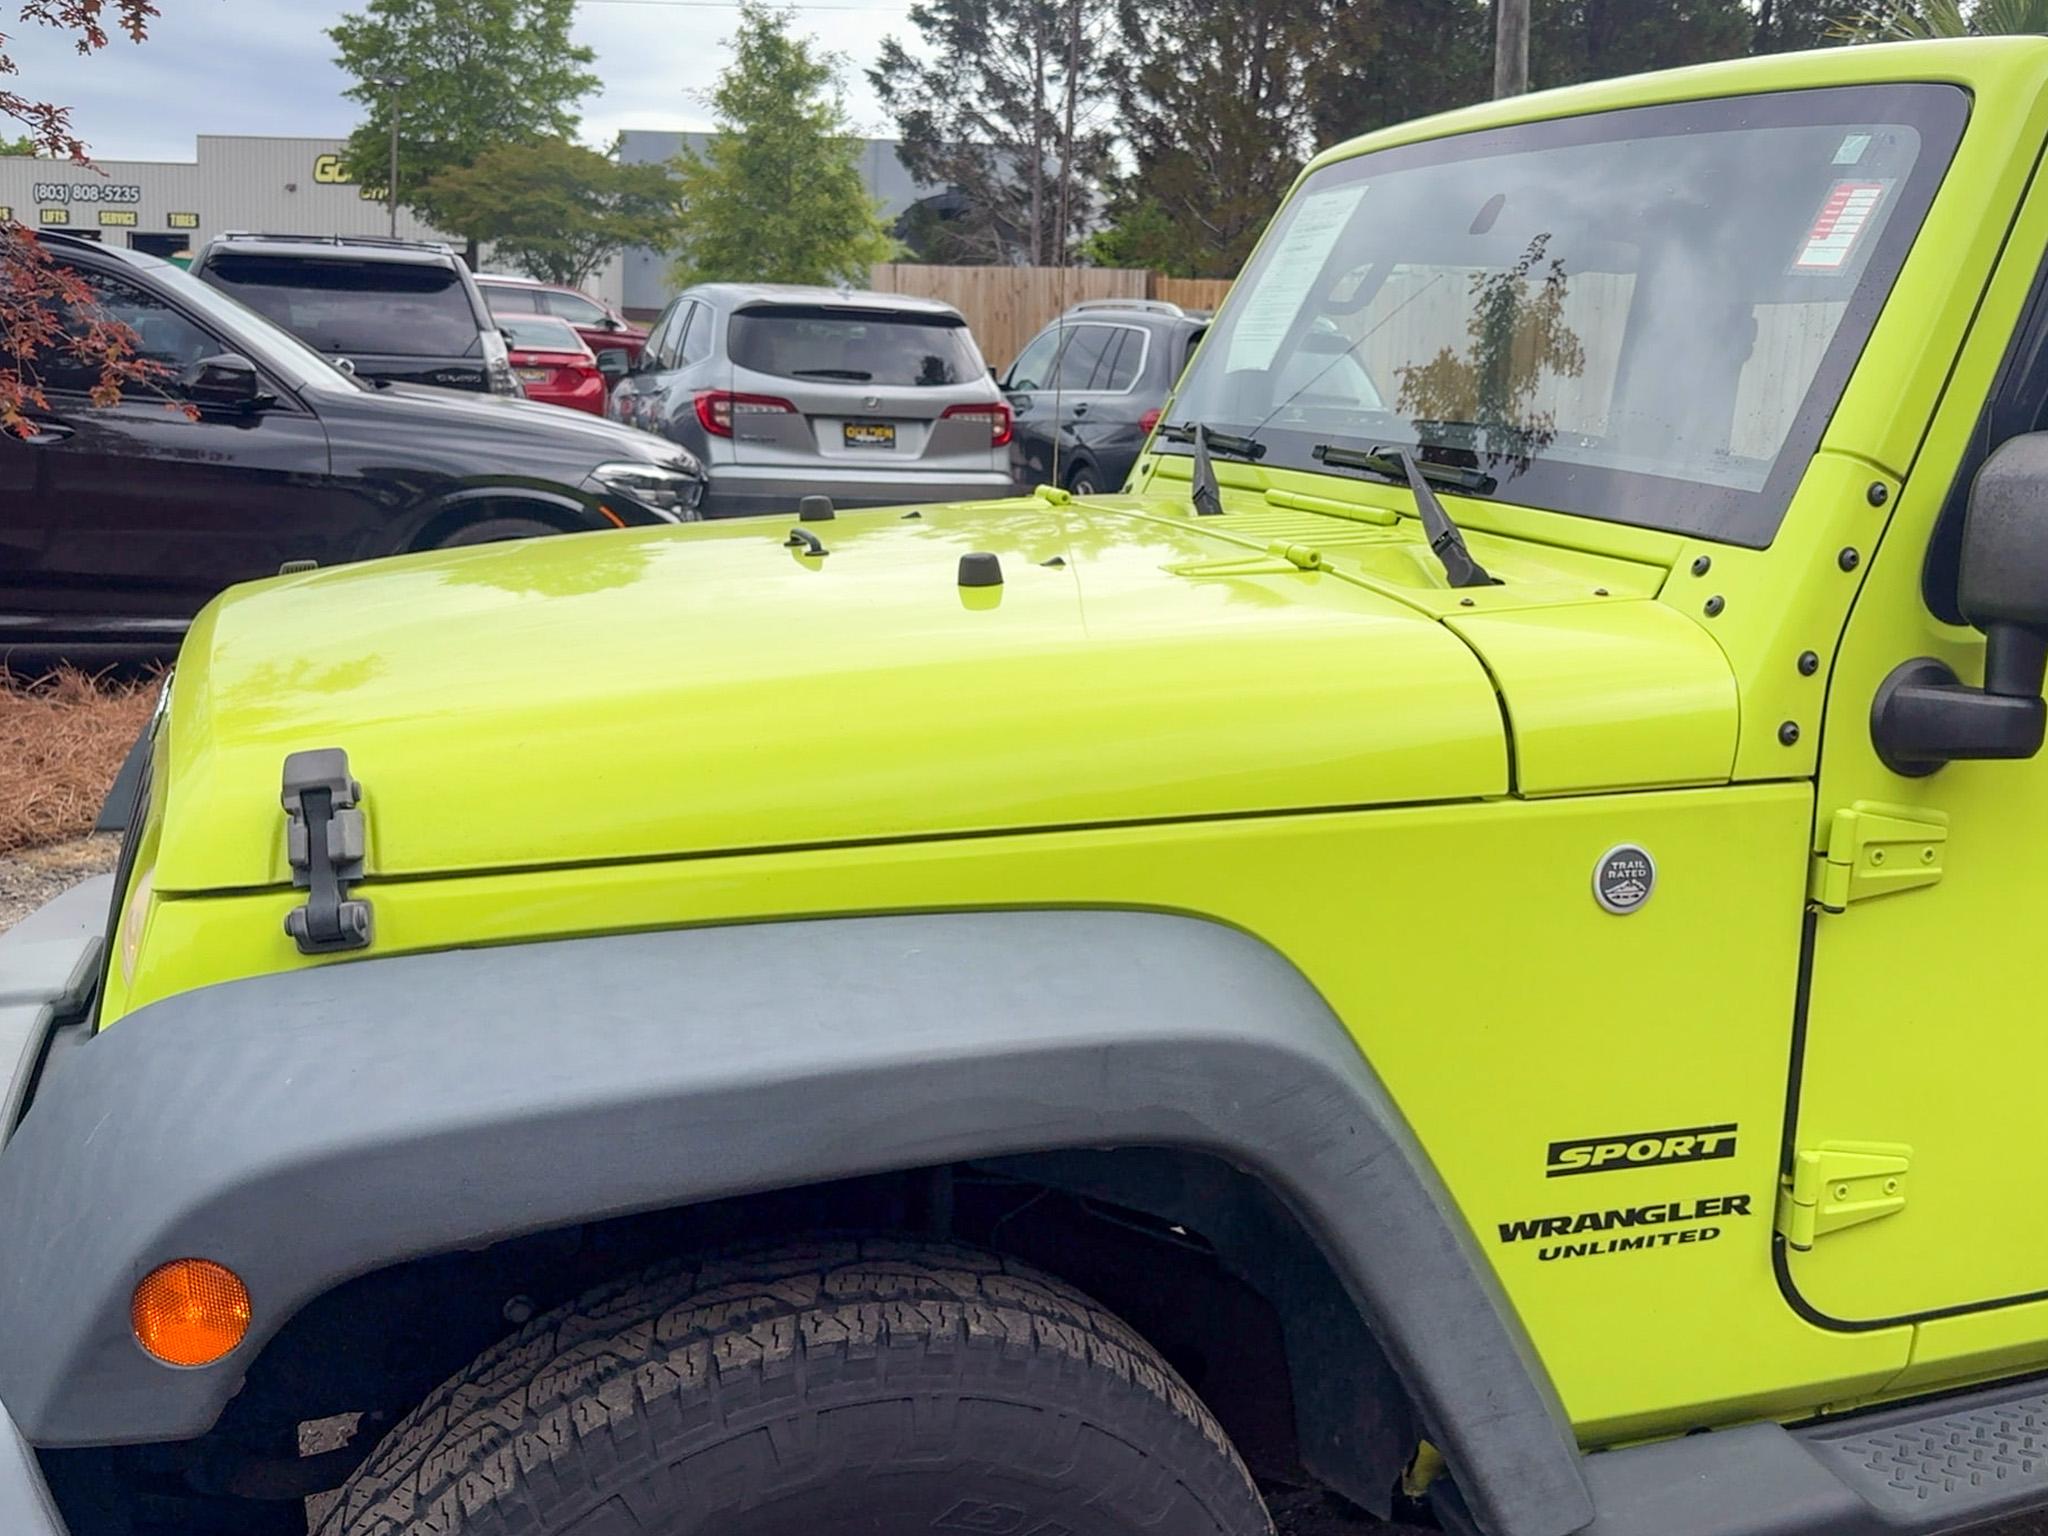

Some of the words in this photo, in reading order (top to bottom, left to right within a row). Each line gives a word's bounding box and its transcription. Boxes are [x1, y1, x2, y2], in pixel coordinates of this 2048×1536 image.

[33, 183, 70, 204] (803)
[72, 184, 140, 203] 808-5235
[1608, 869, 1647, 878] RATED
[1611, 860, 1645, 870] TRAIL
[1548, 1131, 1737, 1172] SPORT
[1498, 1194, 1752, 1243] WRANGLER
[1538, 1228, 1721, 1261] UNLIMITED
